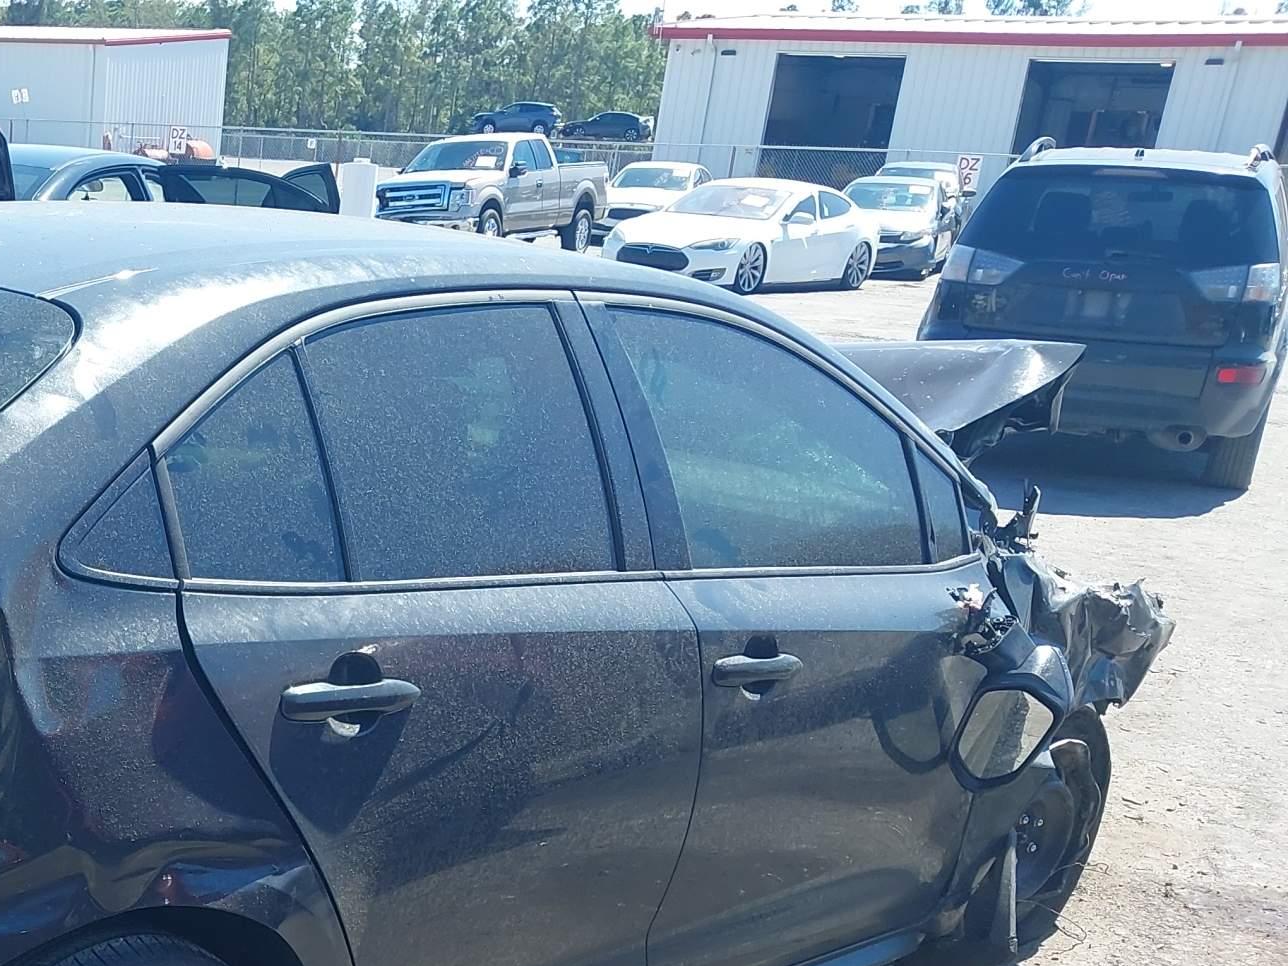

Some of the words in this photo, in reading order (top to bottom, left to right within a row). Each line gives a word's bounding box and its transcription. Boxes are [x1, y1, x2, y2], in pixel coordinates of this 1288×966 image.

[172, 128, 186, 139] DZ
[173, 140, 182, 151] 14
[960, 157, 980, 171] DZ
